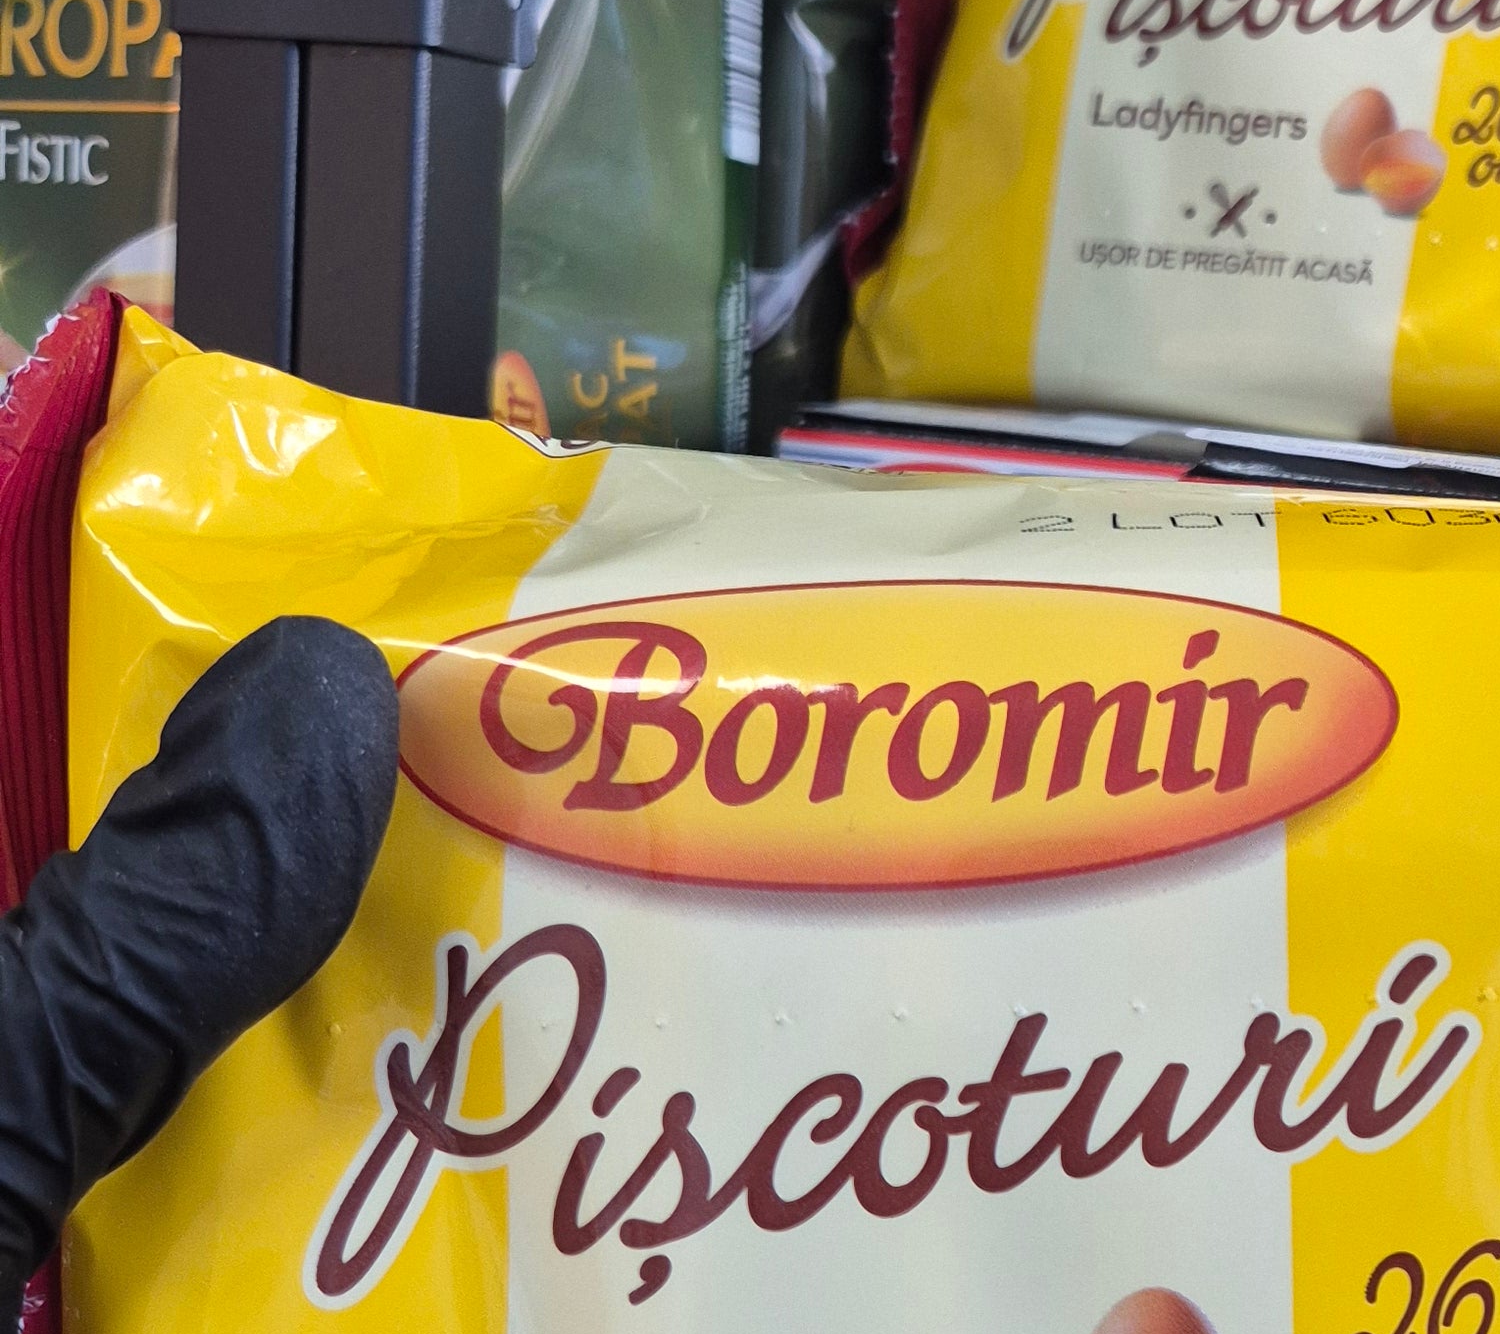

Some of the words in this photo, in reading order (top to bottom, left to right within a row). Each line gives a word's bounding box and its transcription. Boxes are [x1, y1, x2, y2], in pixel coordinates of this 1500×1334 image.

[1091, 93, 1308, 146] Ladyfingers
[1145, 245, 1177, 268] DE
[1182, 246, 1287, 278] PREGĂTIT
[1293, 259, 1374, 287] ACASĂ
[1112, 510, 1282, 531] LOT
[479, 621, 1307, 811] Boromir
[316, 924, 1469, 1305] Pișcoturi
